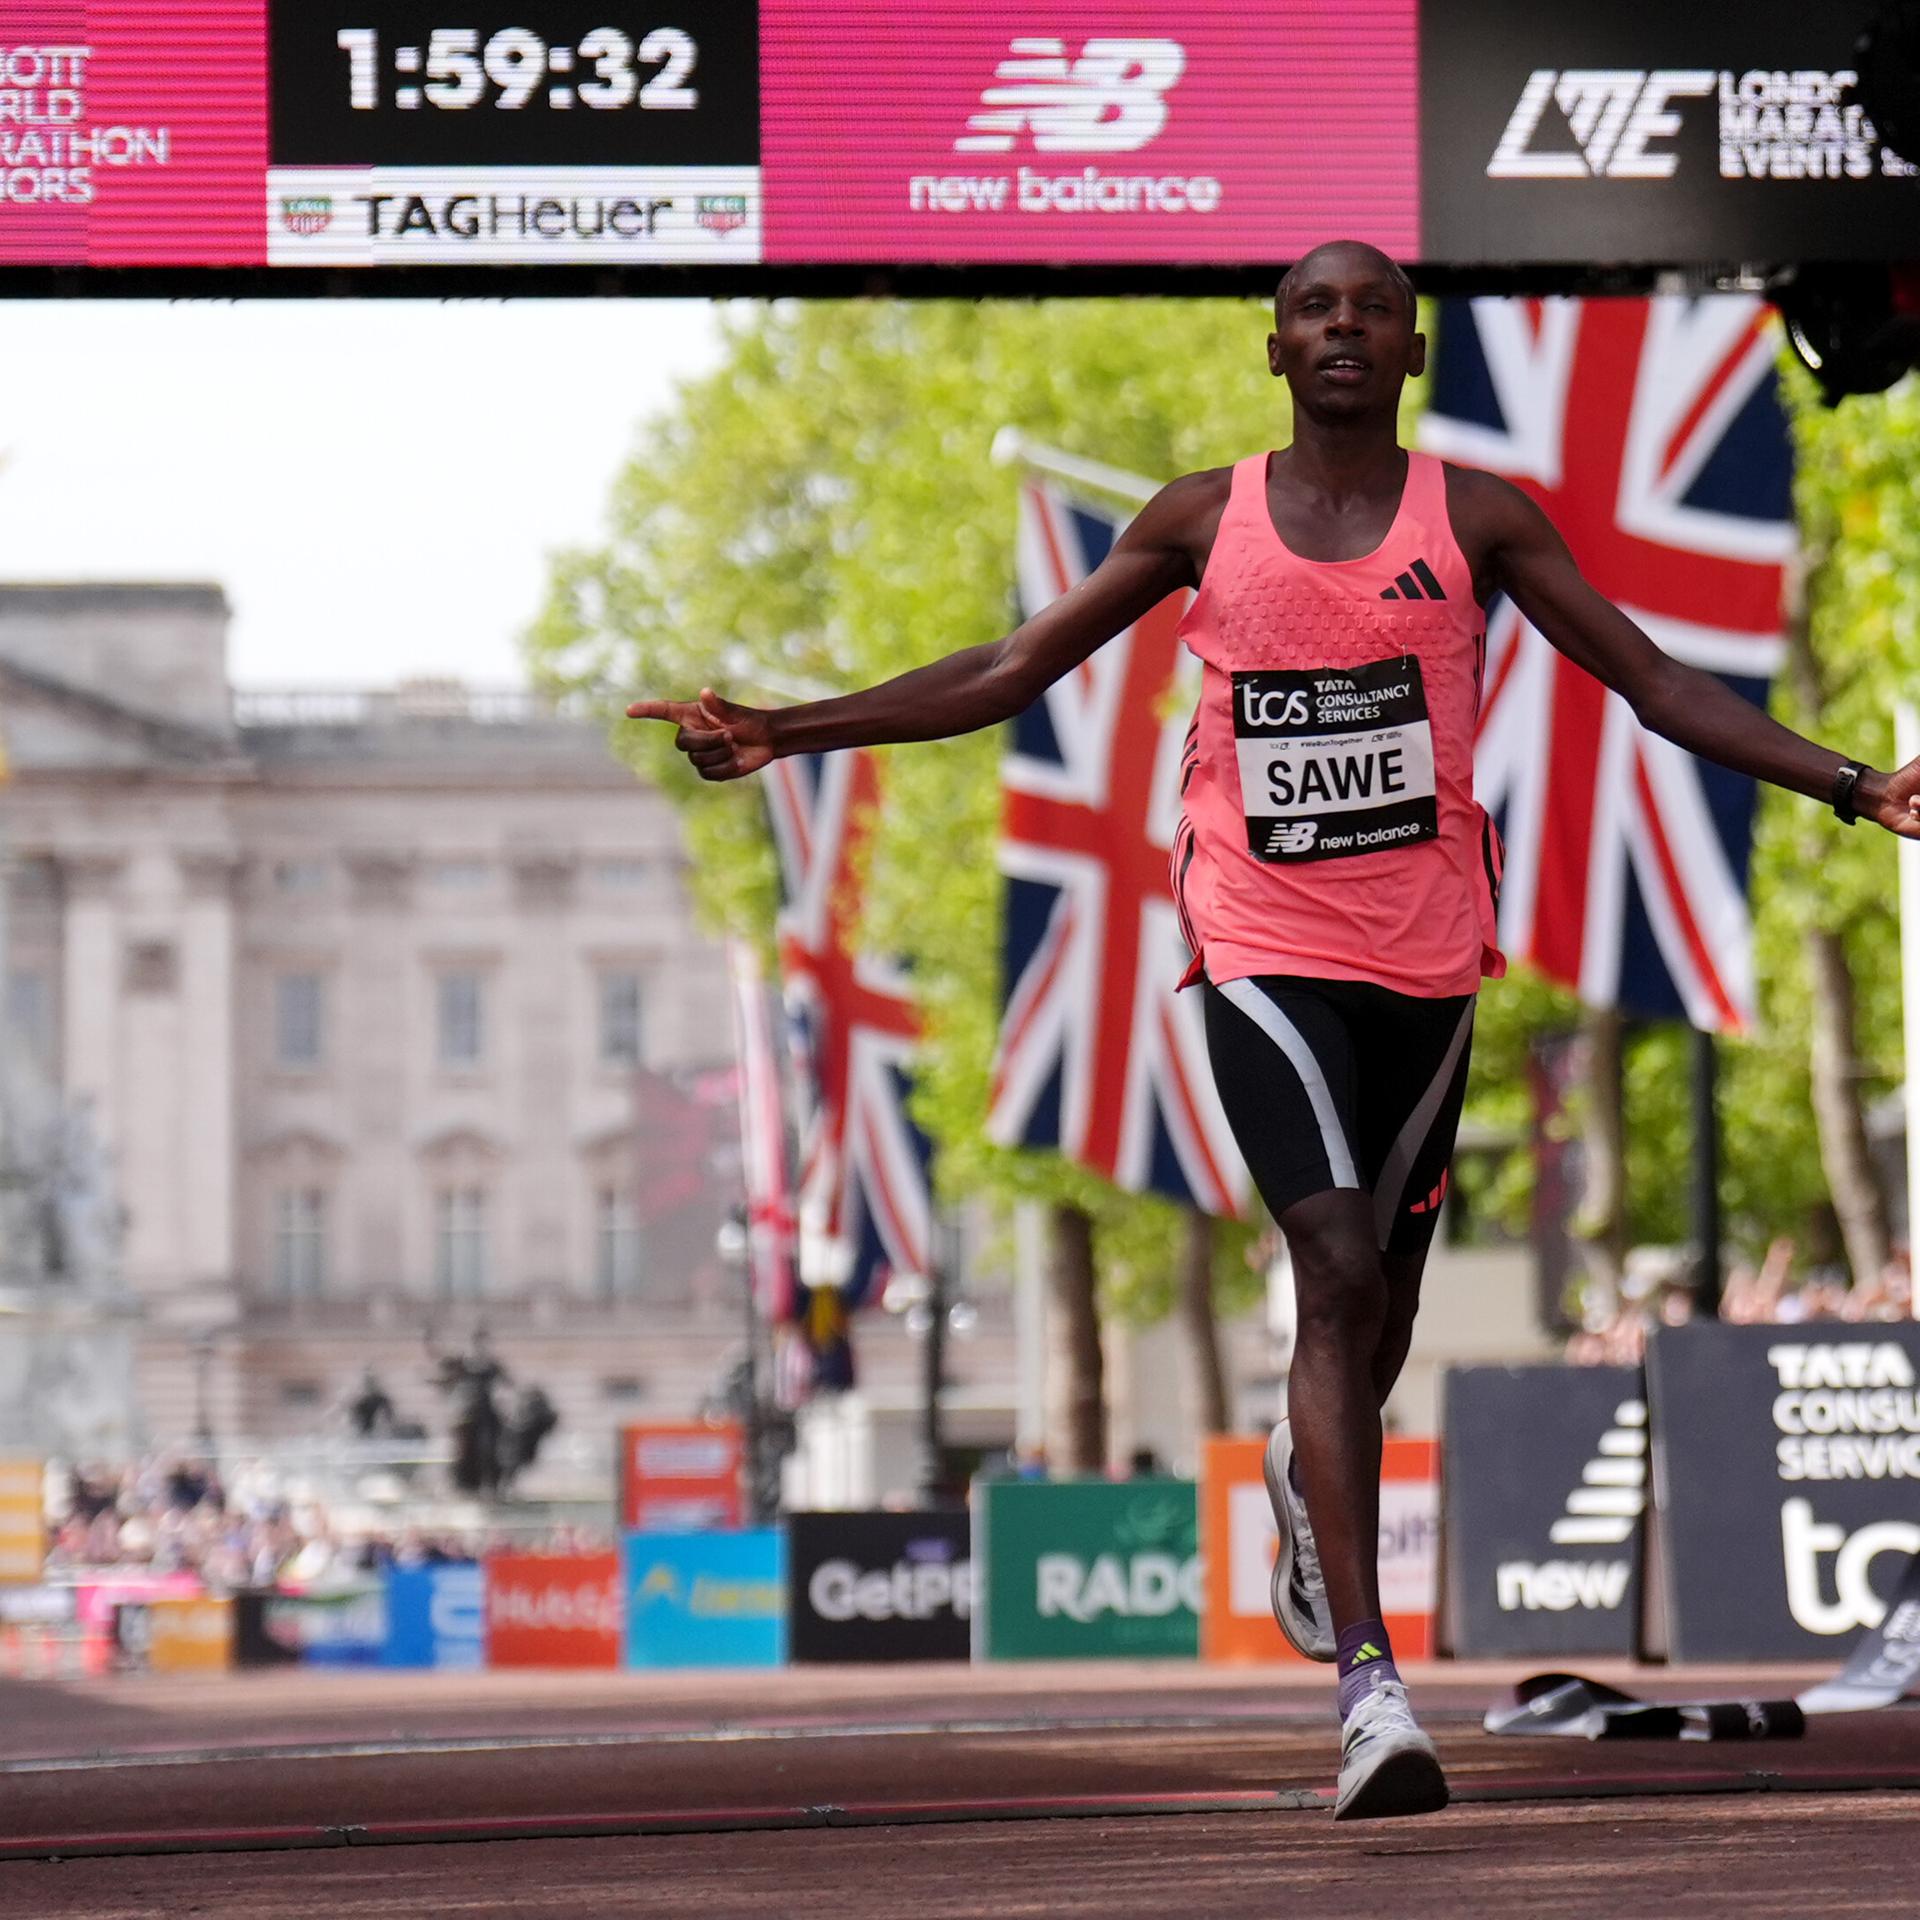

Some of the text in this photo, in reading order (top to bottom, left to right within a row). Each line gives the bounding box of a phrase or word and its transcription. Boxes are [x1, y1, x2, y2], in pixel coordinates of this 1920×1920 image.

[0, 46, 93, 86] OTT
[337, 28, 698, 110] 1:59:32
[1719, 143, 1873, 179] EVENTS
[909, 166, 1222, 213] new balance
[1243, 683, 1310, 726] tcs
[1314, 679, 1357, 693] TATA
[1316, 683, 1411, 709] CONSULTANCY
[1317, 706, 1381, 724] SERVICES
[1266, 748, 1406, 806] SAWE
[1320, 822, 1420, 850] new balance
[1767, 1343, 1915, 1388] TATA
[1496, 1559, 1632, 1611] new
